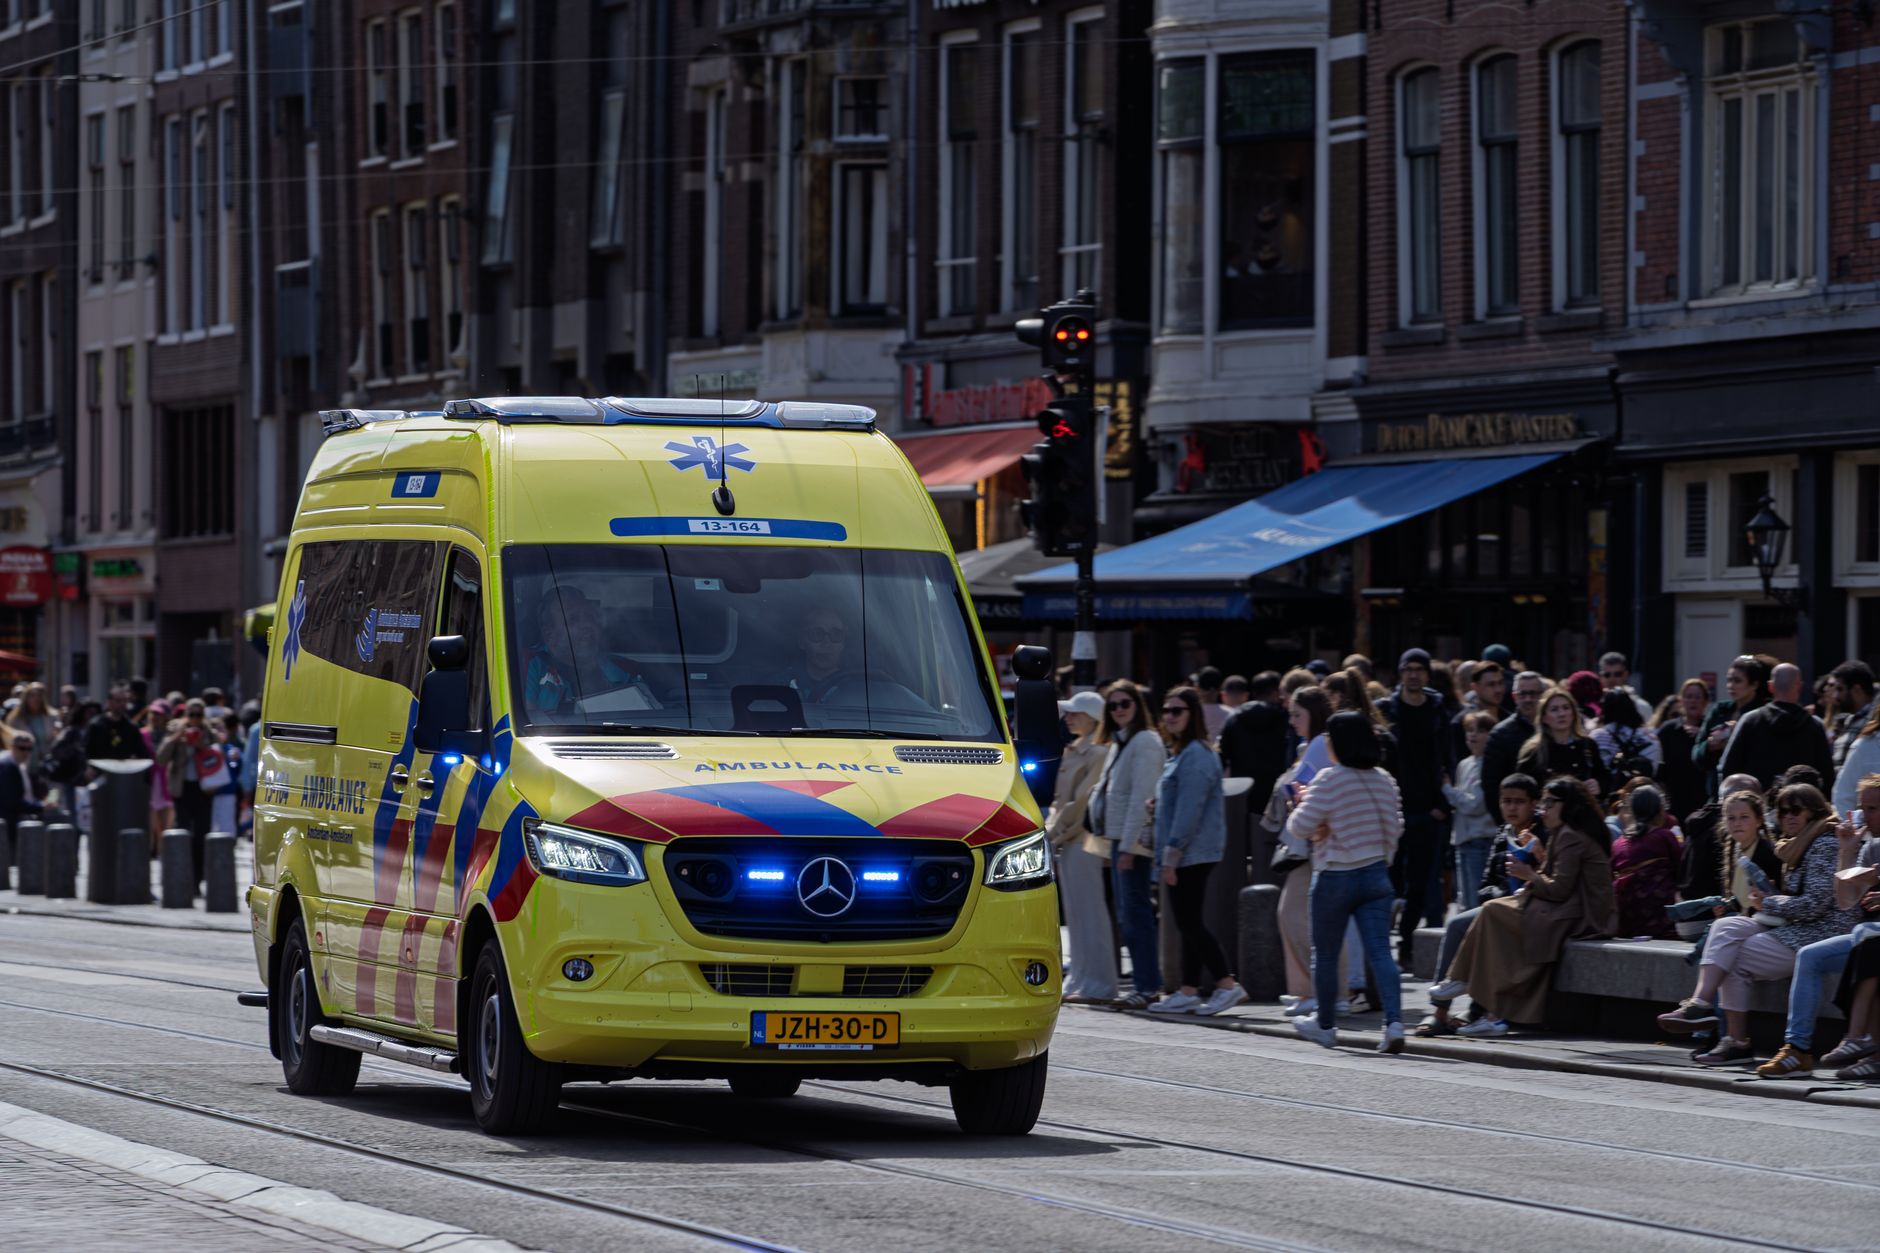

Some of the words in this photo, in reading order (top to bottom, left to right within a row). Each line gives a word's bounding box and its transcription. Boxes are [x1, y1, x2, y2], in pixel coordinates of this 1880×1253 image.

[1427, 413, 1507, 449] PANCAKE
[1510, 412, 1577, 443] MASTERS
[700, 521, 761, 532] 13-164
[694, 761, 904, 775] AMBULANCE
[264, 769, 290, 805] 13-164
[301, 774, 367, 815] AMBULANCE
[753, 1030, 765, 1038] NL
[775, 1017, 888, 1040] JZH-30-D
